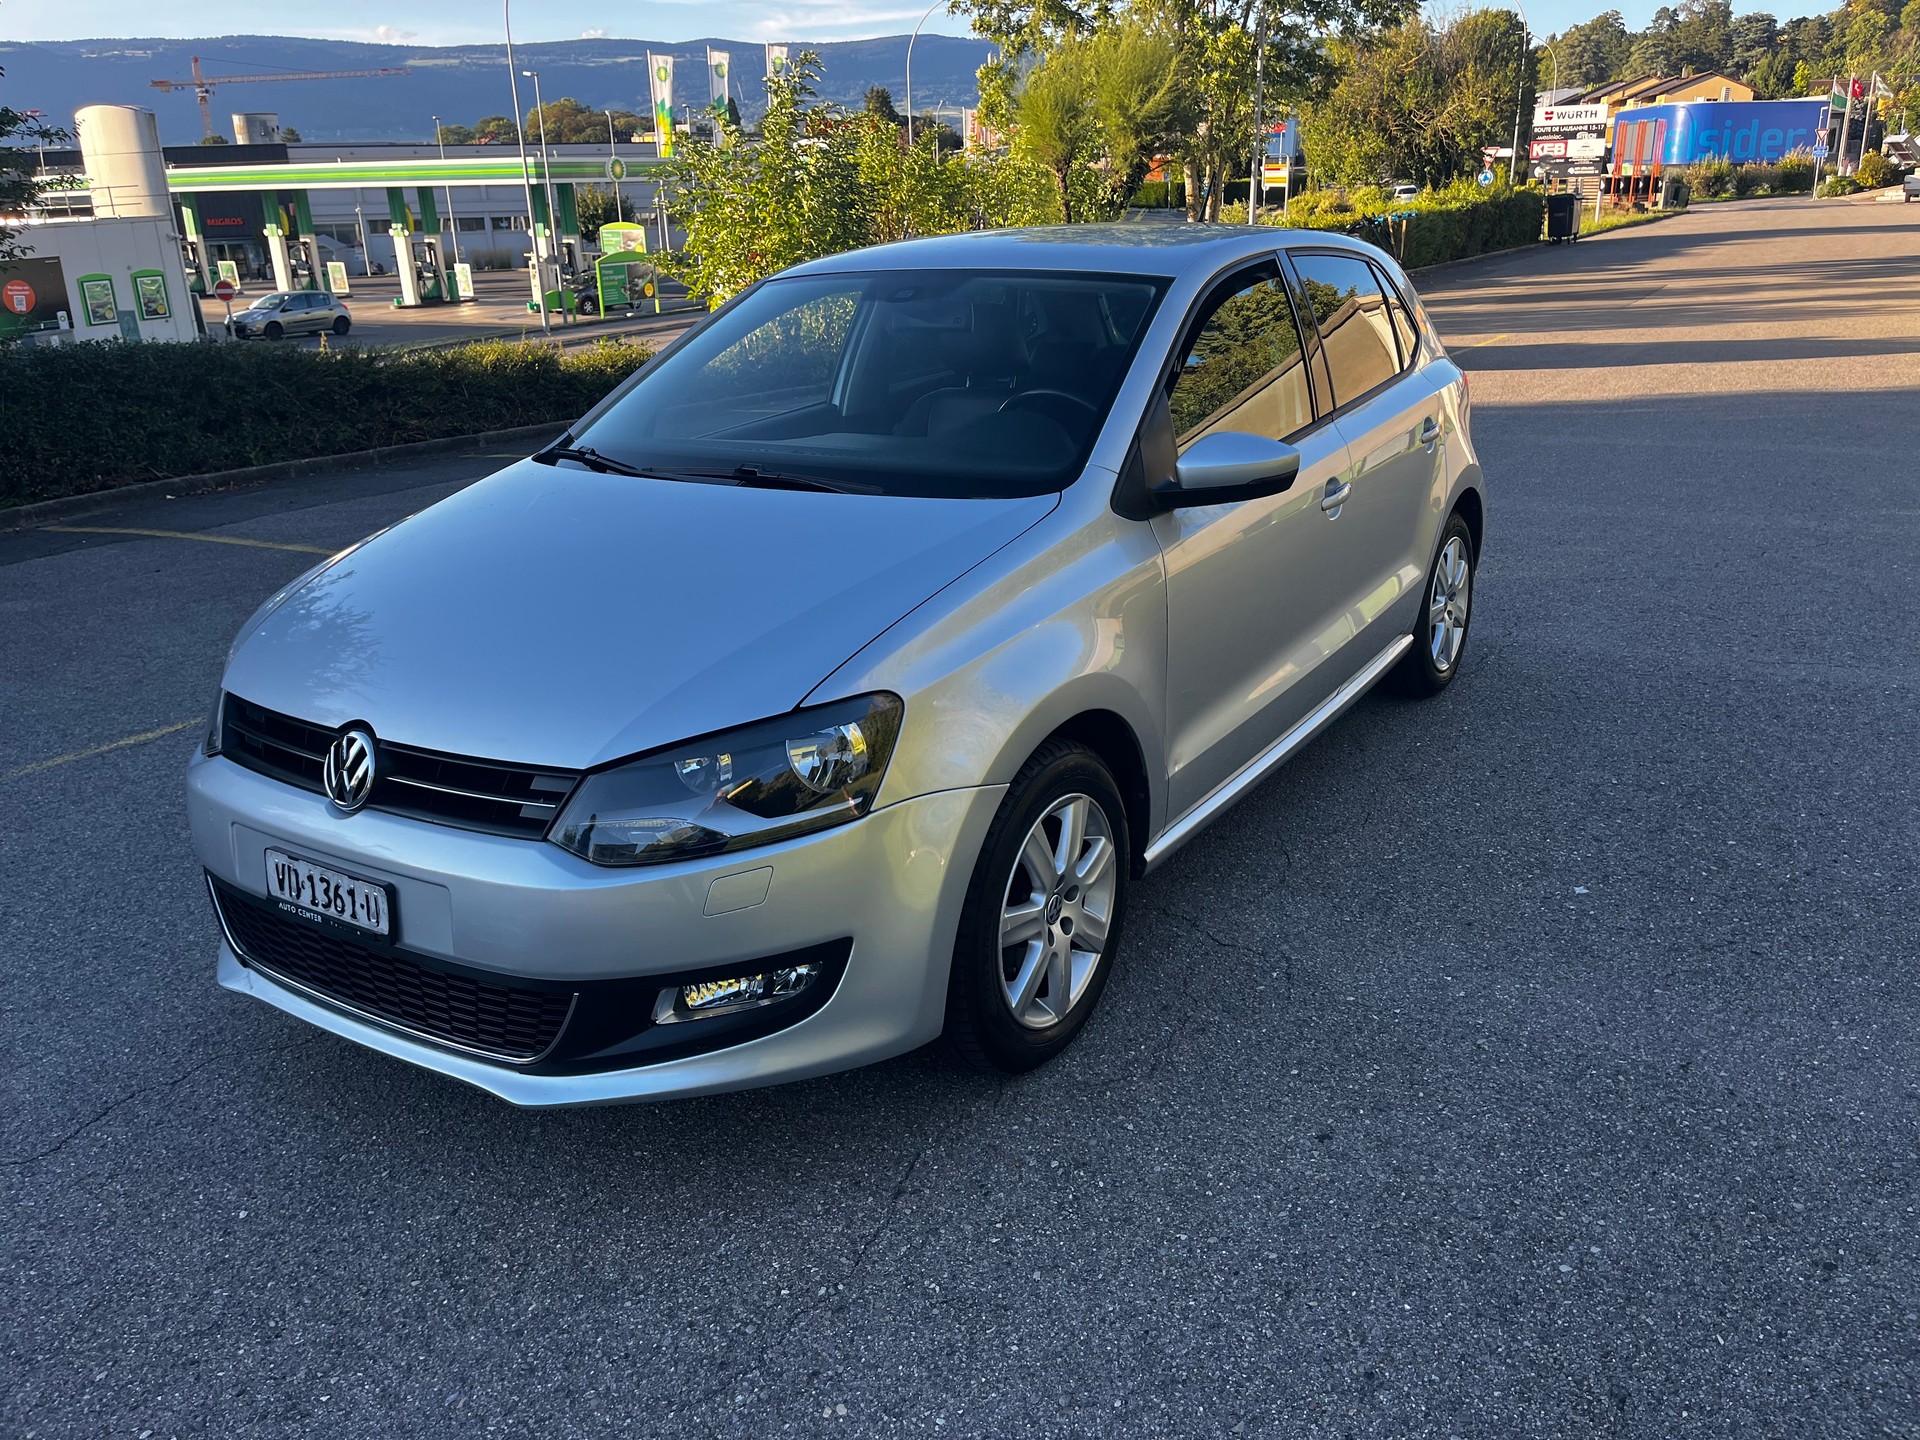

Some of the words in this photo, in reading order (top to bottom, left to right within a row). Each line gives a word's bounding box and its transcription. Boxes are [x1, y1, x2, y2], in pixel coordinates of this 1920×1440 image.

[1556, 110, 1598, 120] WÜRTH
[1532, 143, 1565, 156] KEB
[207, 217, 244, 225] MIGROS
[278, 902, 297, 914] AUTO
[297, 908, 323, 924] CENTER
